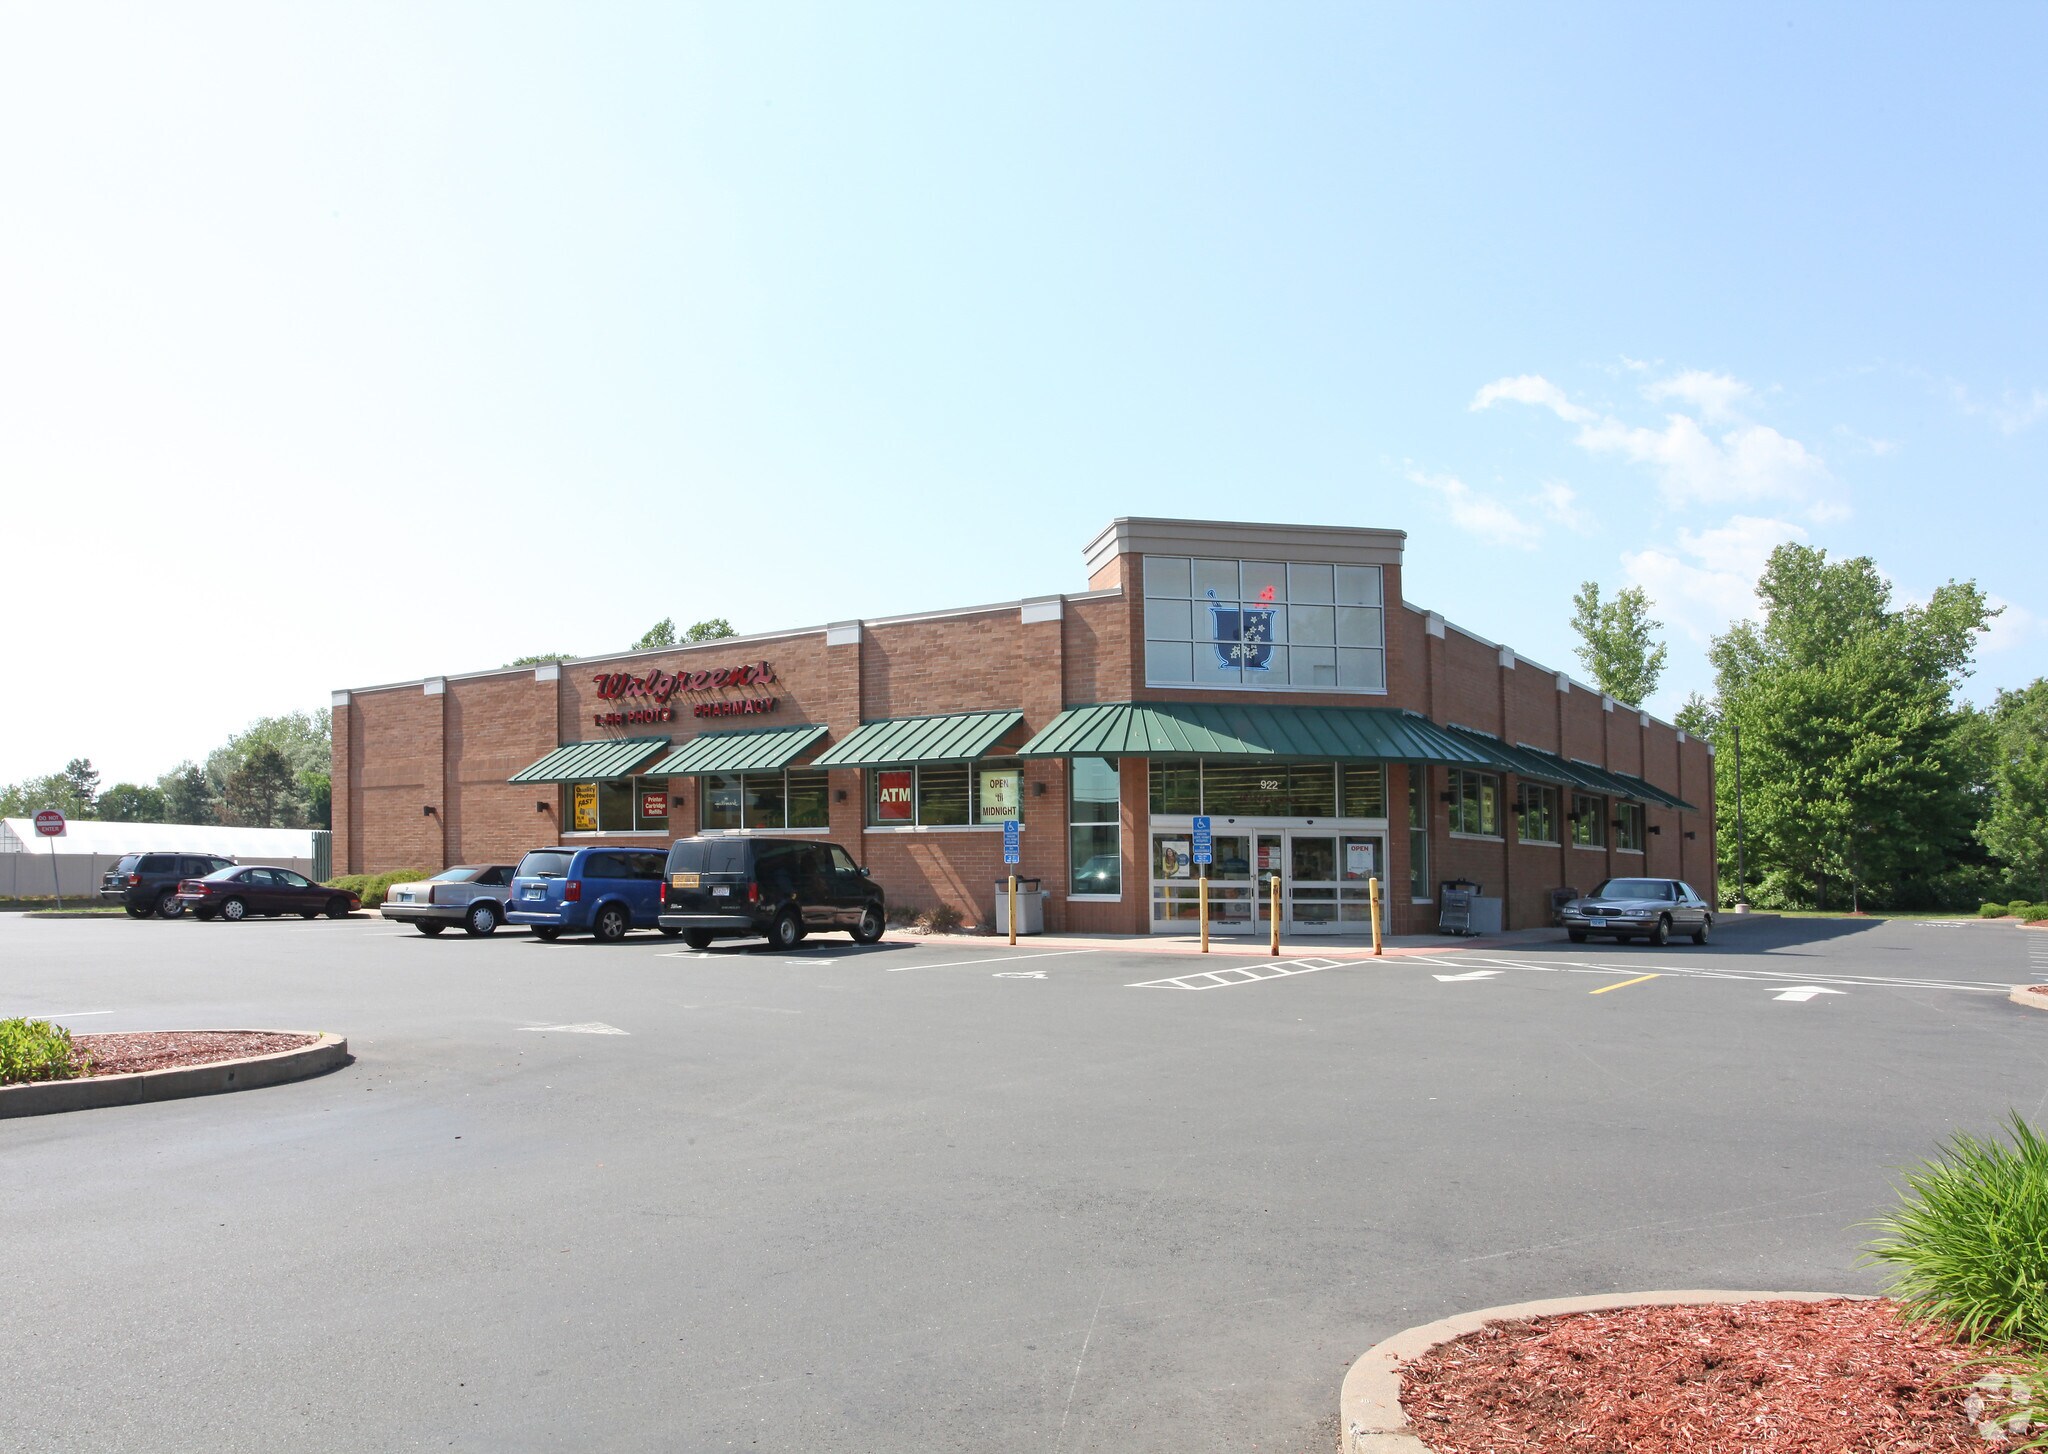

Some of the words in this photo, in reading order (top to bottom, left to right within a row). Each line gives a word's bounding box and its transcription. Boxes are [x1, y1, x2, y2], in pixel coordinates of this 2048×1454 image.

[593, 661, 775, 704] Walgreens
[694, 697, 775, 717] PHARMACY
[627, 707, 672, 724] PHOTO
[989, 779, 1009, 788] OPEN
[1260, 780, 1278, 790] 922
[880, 787, 911, 802] ATM
[578, 799, 593, 807] FAST
[982, 806, 1016, 816] MIDNIGHT
